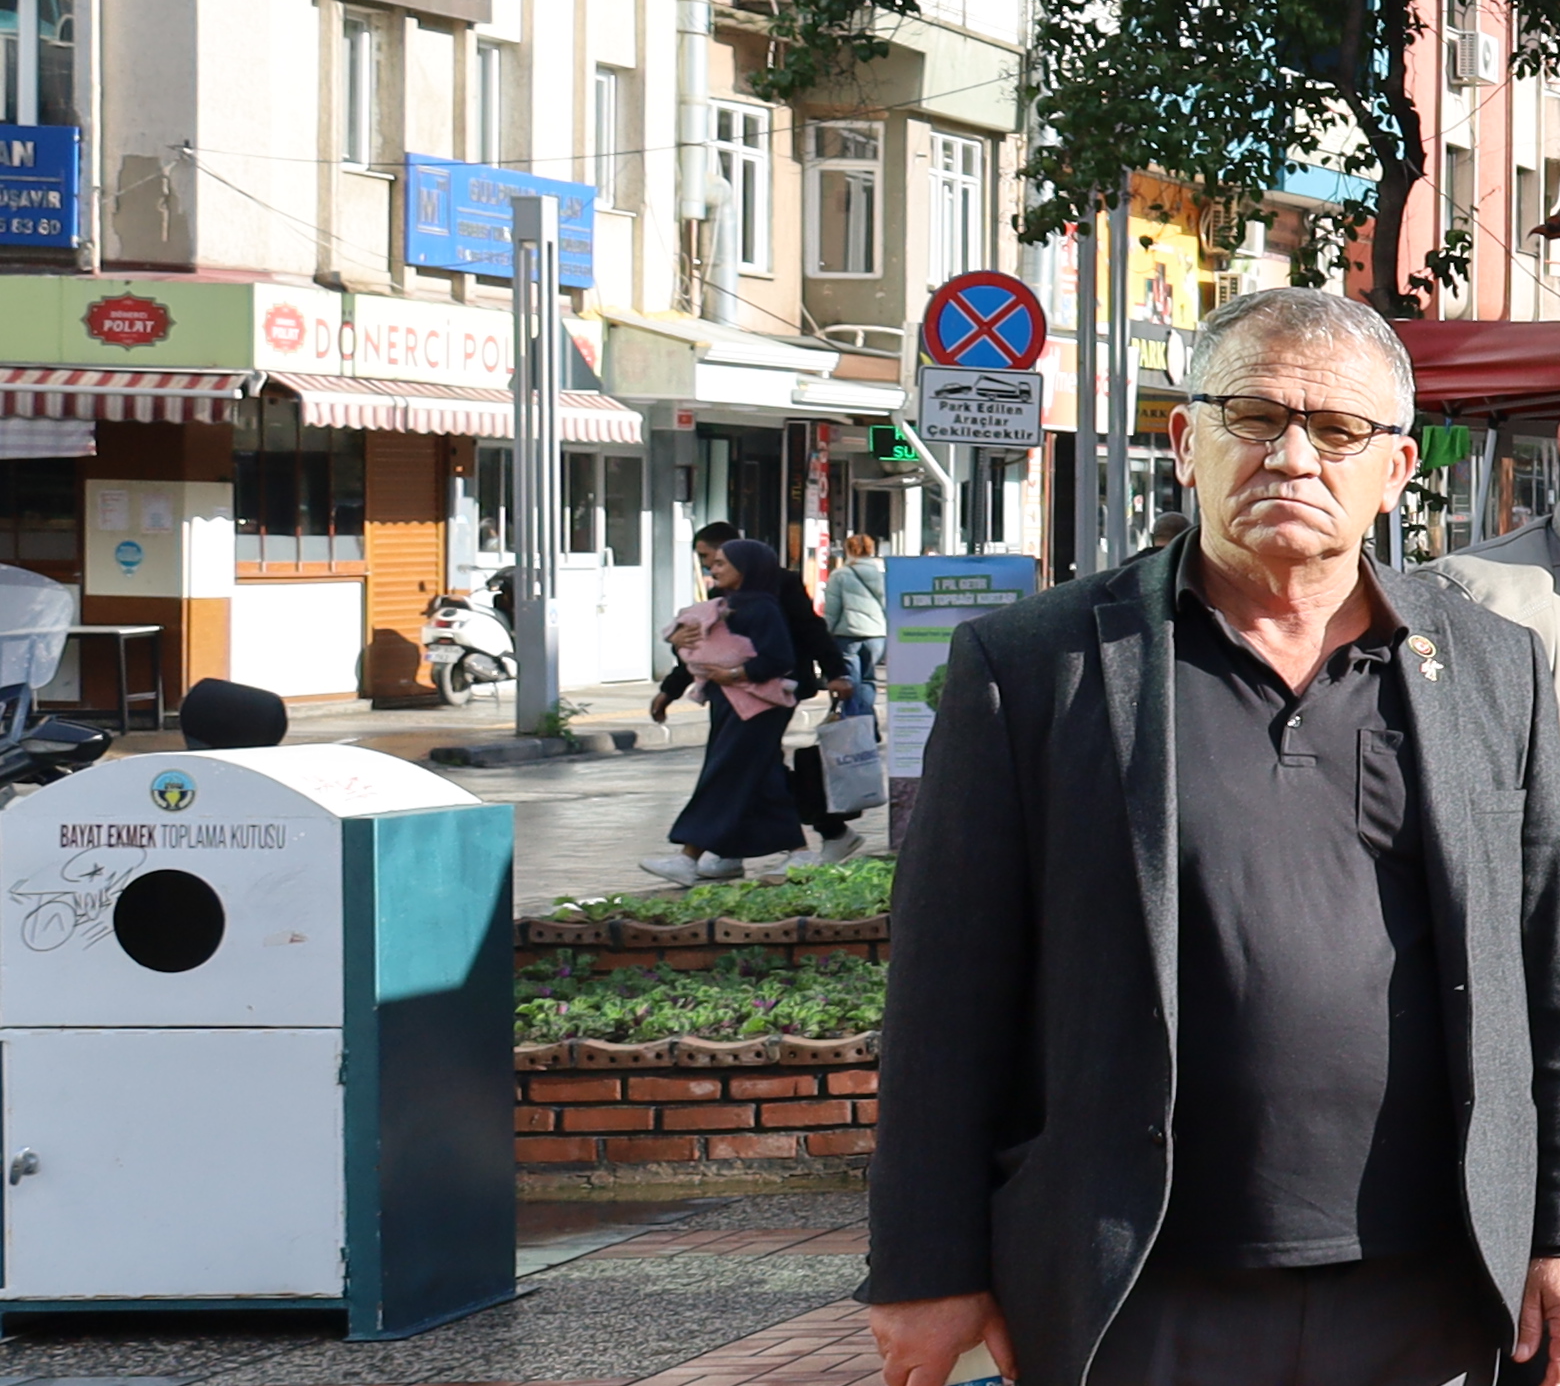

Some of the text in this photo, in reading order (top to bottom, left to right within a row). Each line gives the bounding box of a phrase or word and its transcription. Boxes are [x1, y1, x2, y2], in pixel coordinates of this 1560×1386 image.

[103, 319, 155, 334] POLAT
[315, 309, 515, 375] DÖNERCİ POL
[938, 400, 1024, 415] Park Edilen
[953, 413, 1010, 429] Araçlar
[926, 424, 1034, 441] Çekilecektir
[60, 824, 287, 850] BAYAT EKMEK TOPLAMA KUTUSU
